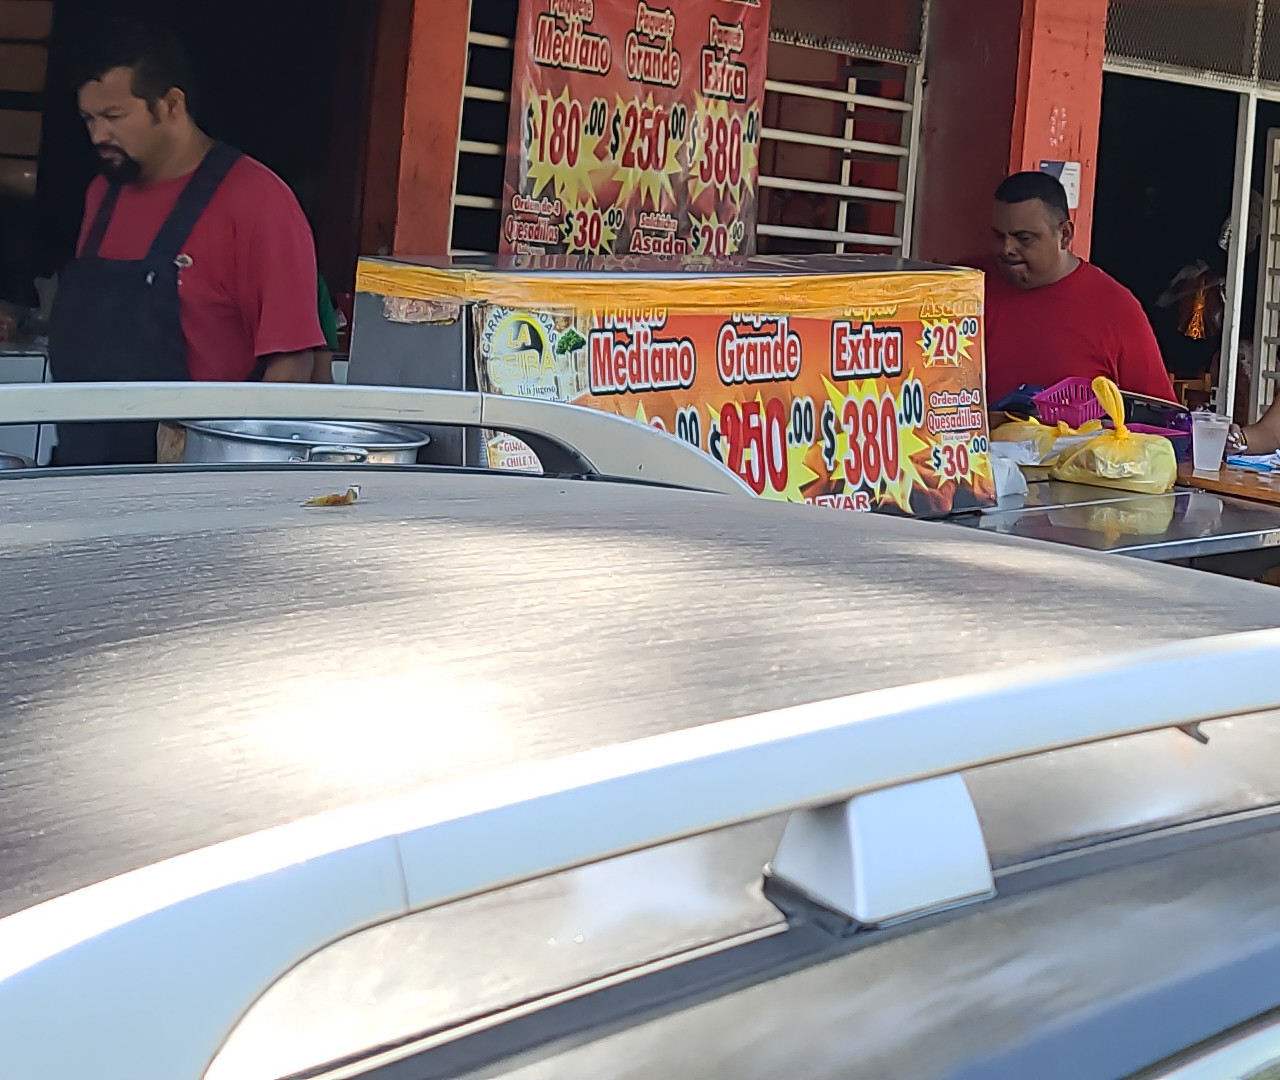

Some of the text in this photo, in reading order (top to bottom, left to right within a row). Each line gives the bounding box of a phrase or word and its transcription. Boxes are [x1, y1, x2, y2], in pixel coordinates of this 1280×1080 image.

[536, 19, 610, 72] Mediano
[626, 31, 680, 85] Grande
[703, 48, 746, 100] Extra
[631, 228, 687, 255] Asada
[506, 322, 531, 349] LA
[590, 330, 695, 390] Mediano
[719, 323, 800, 382] Grande
[833, 322, 902, 375] Extra
[927, 407, 982, 434] Quesadillas
[930, 390, 980, 407] Orden de 4
